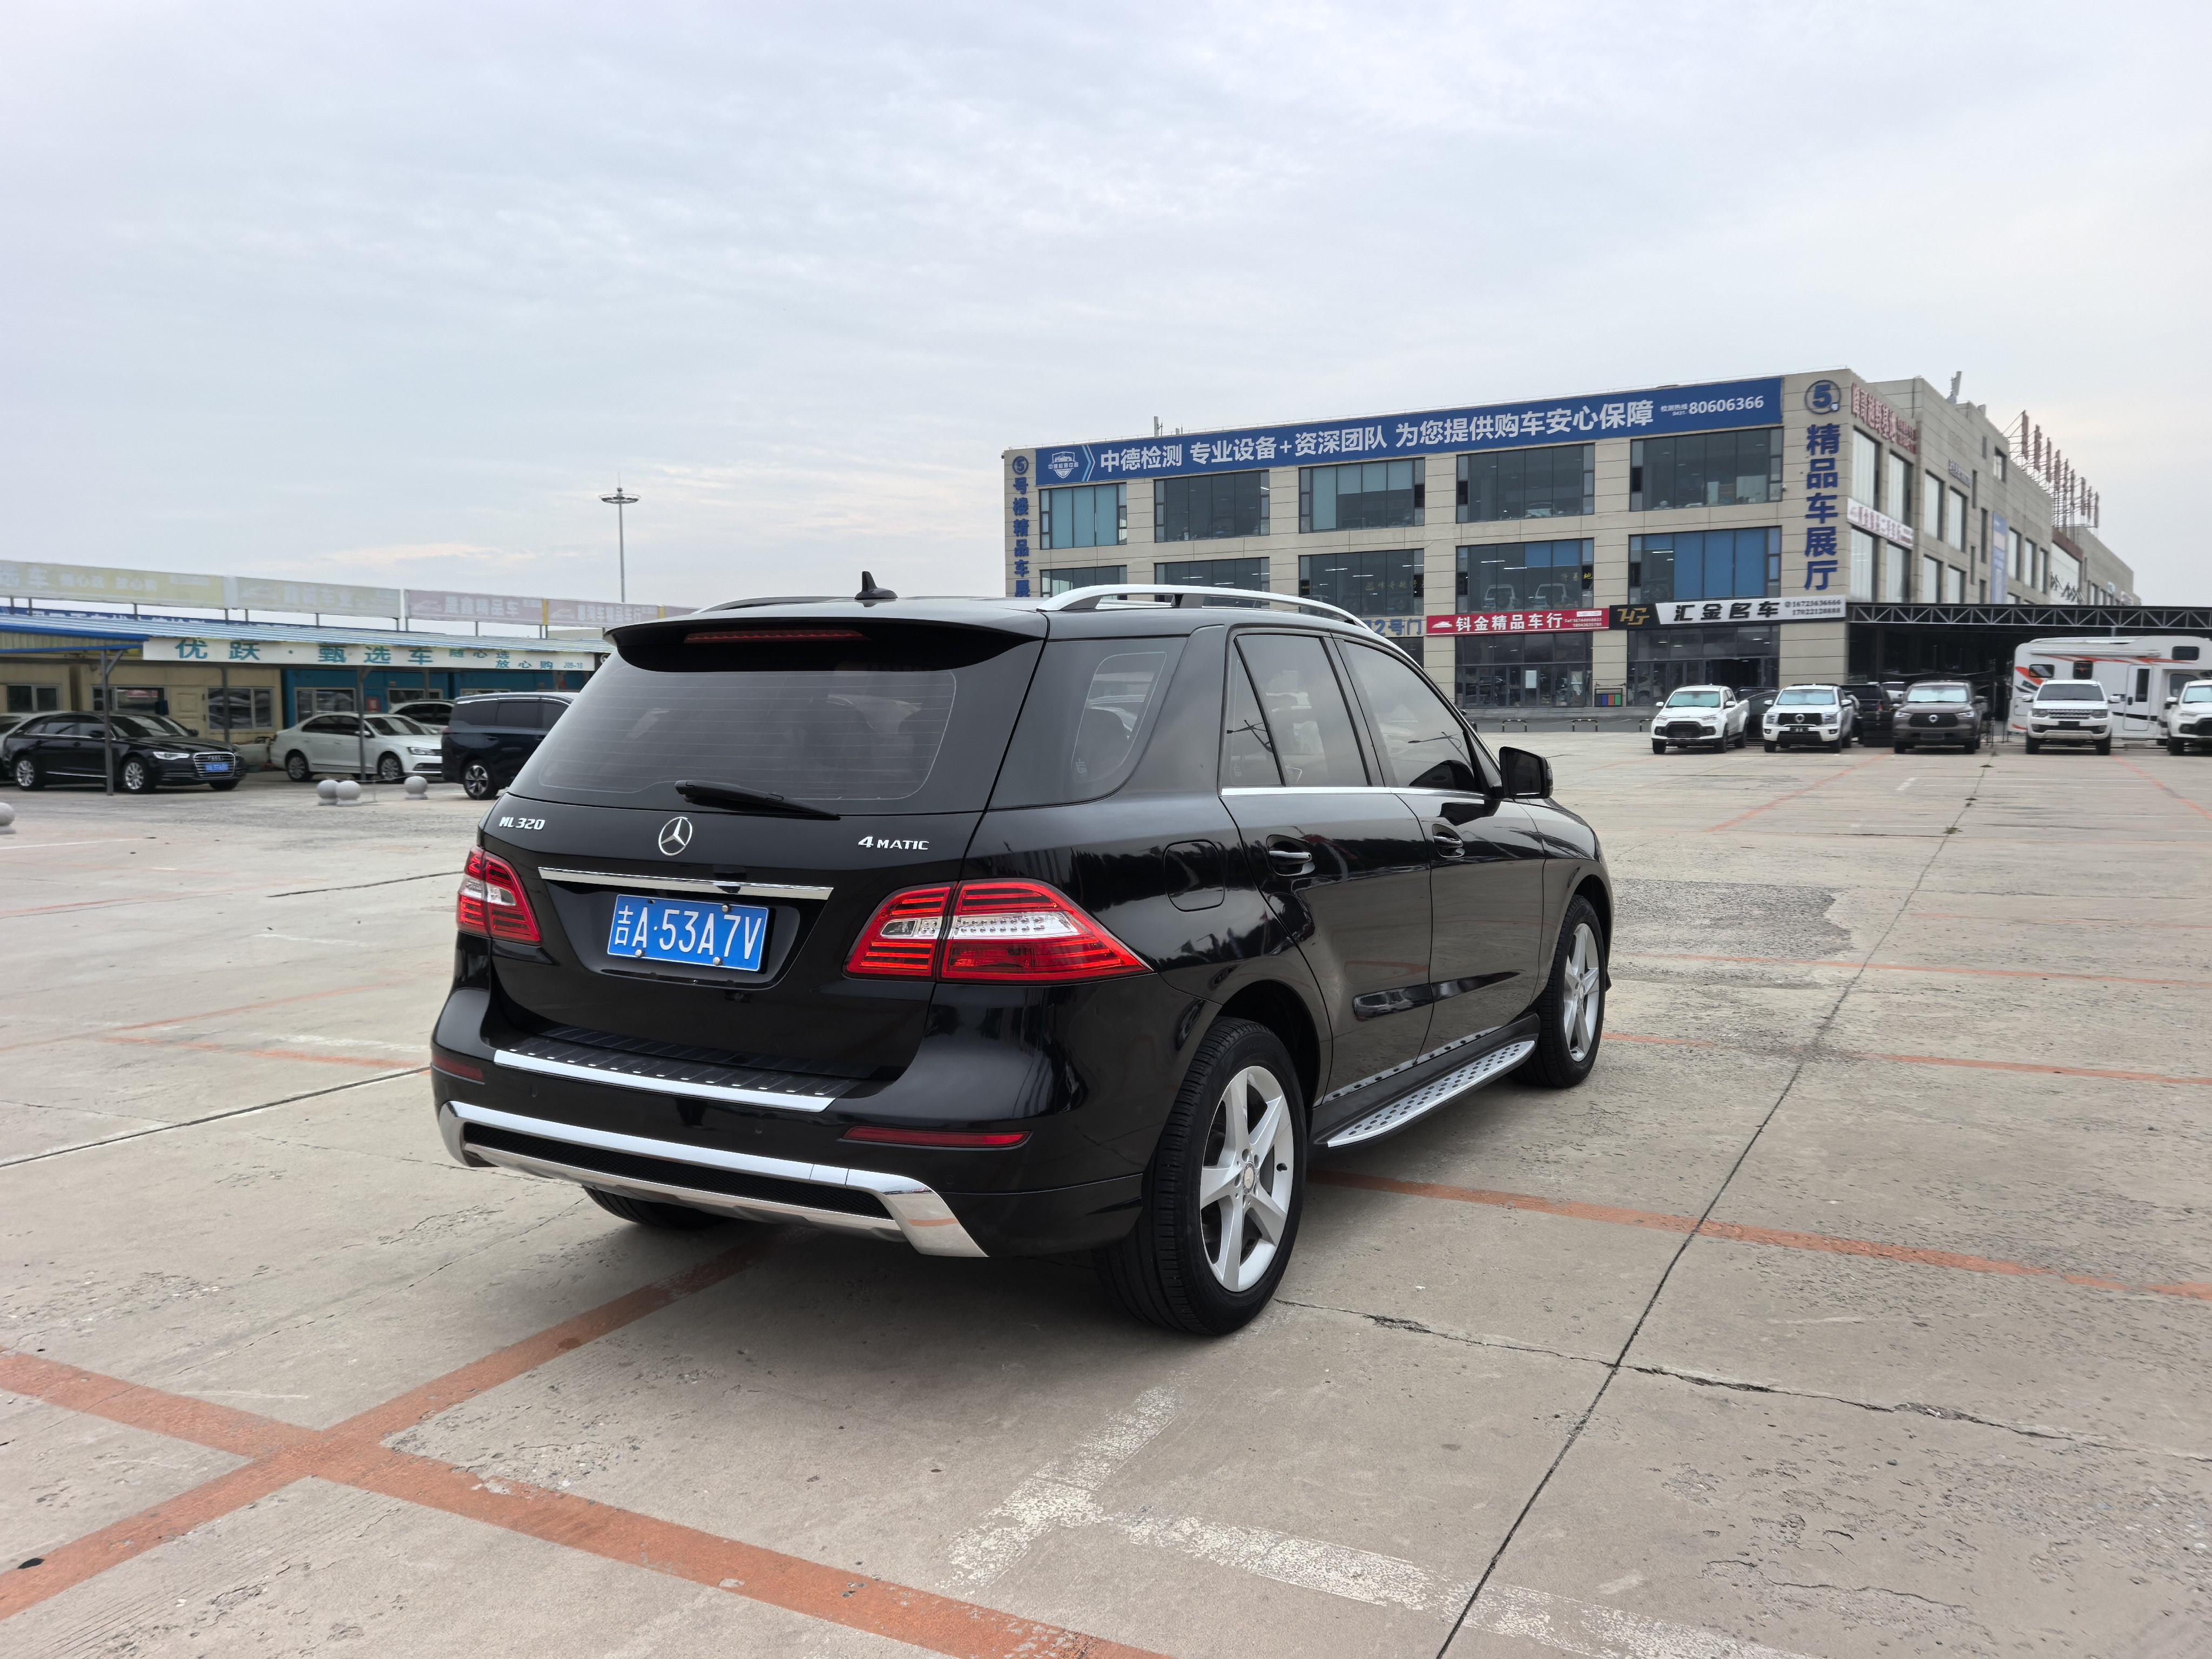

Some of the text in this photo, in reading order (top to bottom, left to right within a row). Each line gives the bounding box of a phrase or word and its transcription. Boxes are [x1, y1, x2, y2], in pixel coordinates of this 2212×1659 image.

[1689, 395, 1764, 415] 80606366
[1101, 399, 1654, 473] 中德检测 专业设备+资深团队 为您提供购车安心保障
[1804, 423, 1840, 590] 精品车展厅
[1674, 601, 1781, 622] 汇金名车
[495, 659, 554, 670] 放心购
